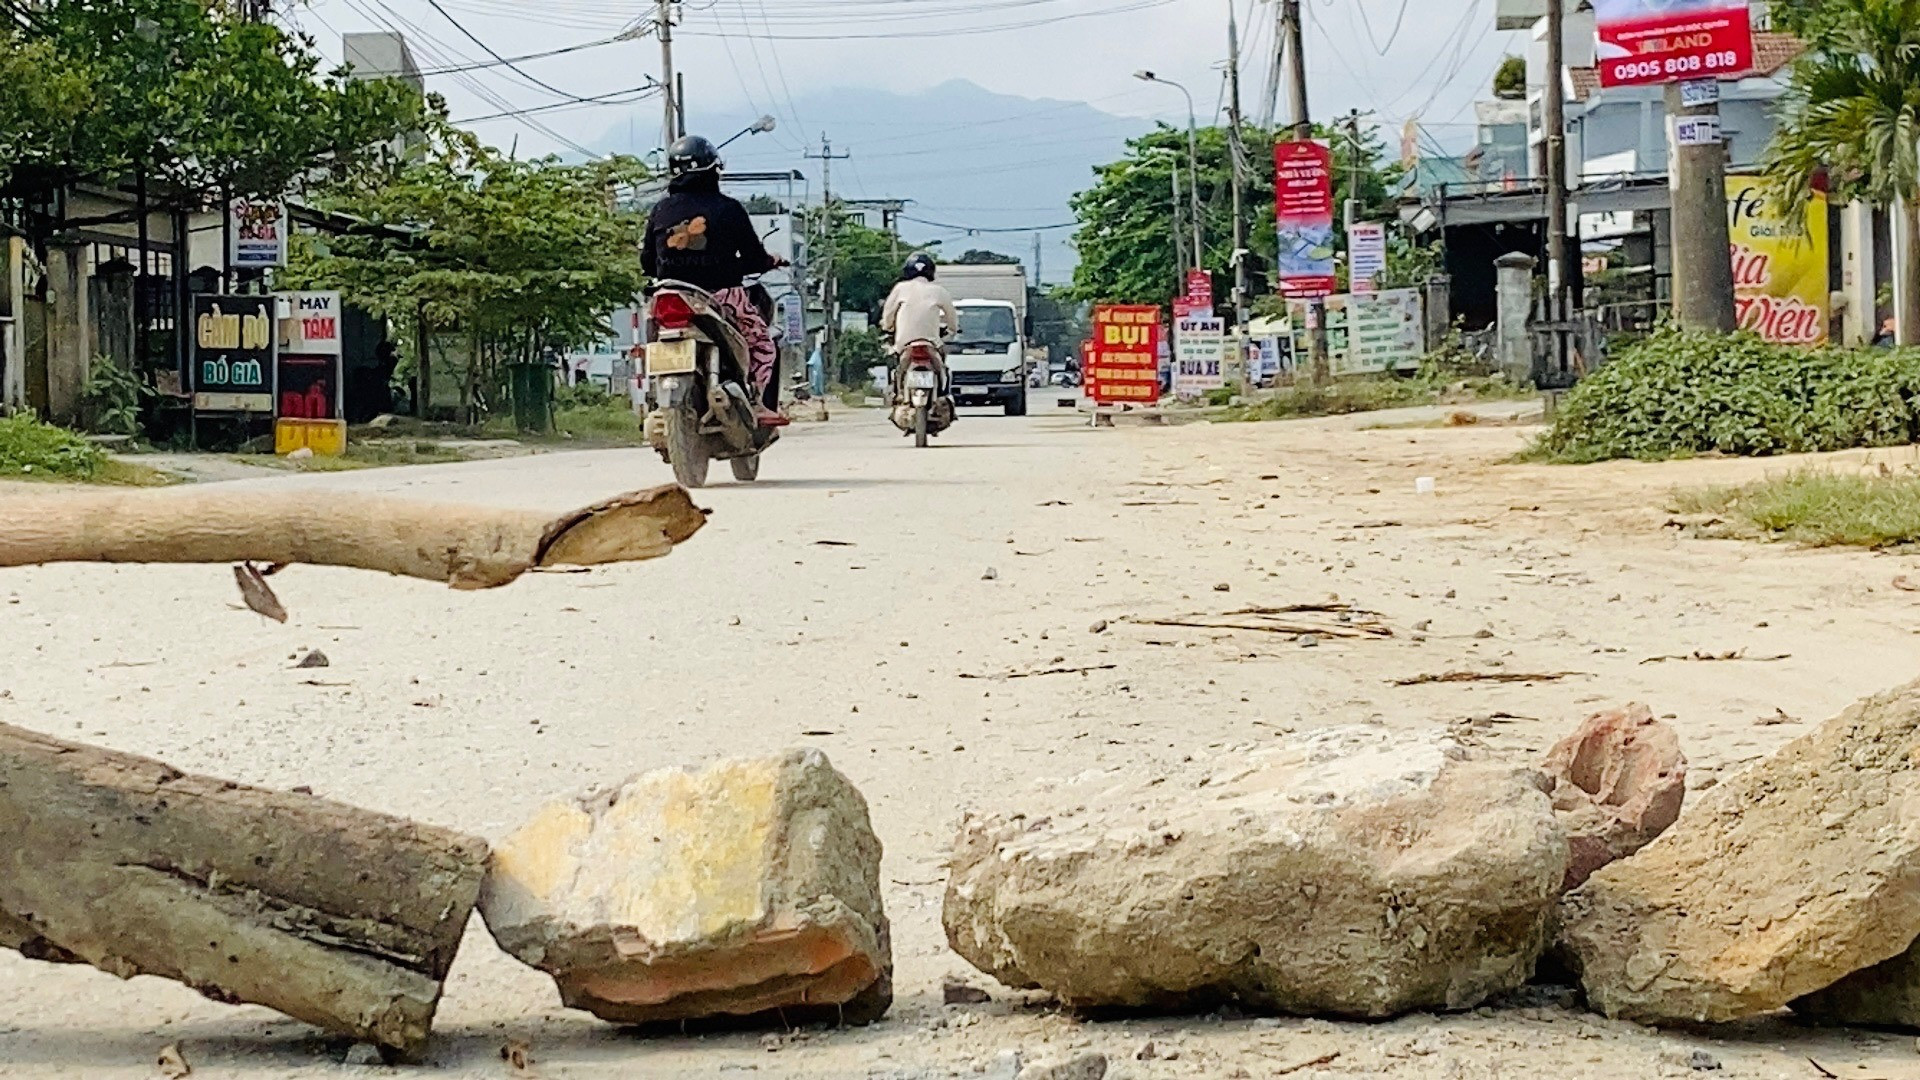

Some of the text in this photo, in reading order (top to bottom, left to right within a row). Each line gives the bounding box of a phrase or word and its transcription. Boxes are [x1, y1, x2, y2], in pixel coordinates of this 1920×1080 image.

[1614, 51, 1737, 80] 0905 808 818
[302, 312, 336, 340] TÂM
[1104, 325, 1149, 350] BỤI
[1181, 320, 1220, 331] ÚT AN
[203, 354, 263, 385] BỐ GIÀ
[1206, 360, 1220, 375] XE
